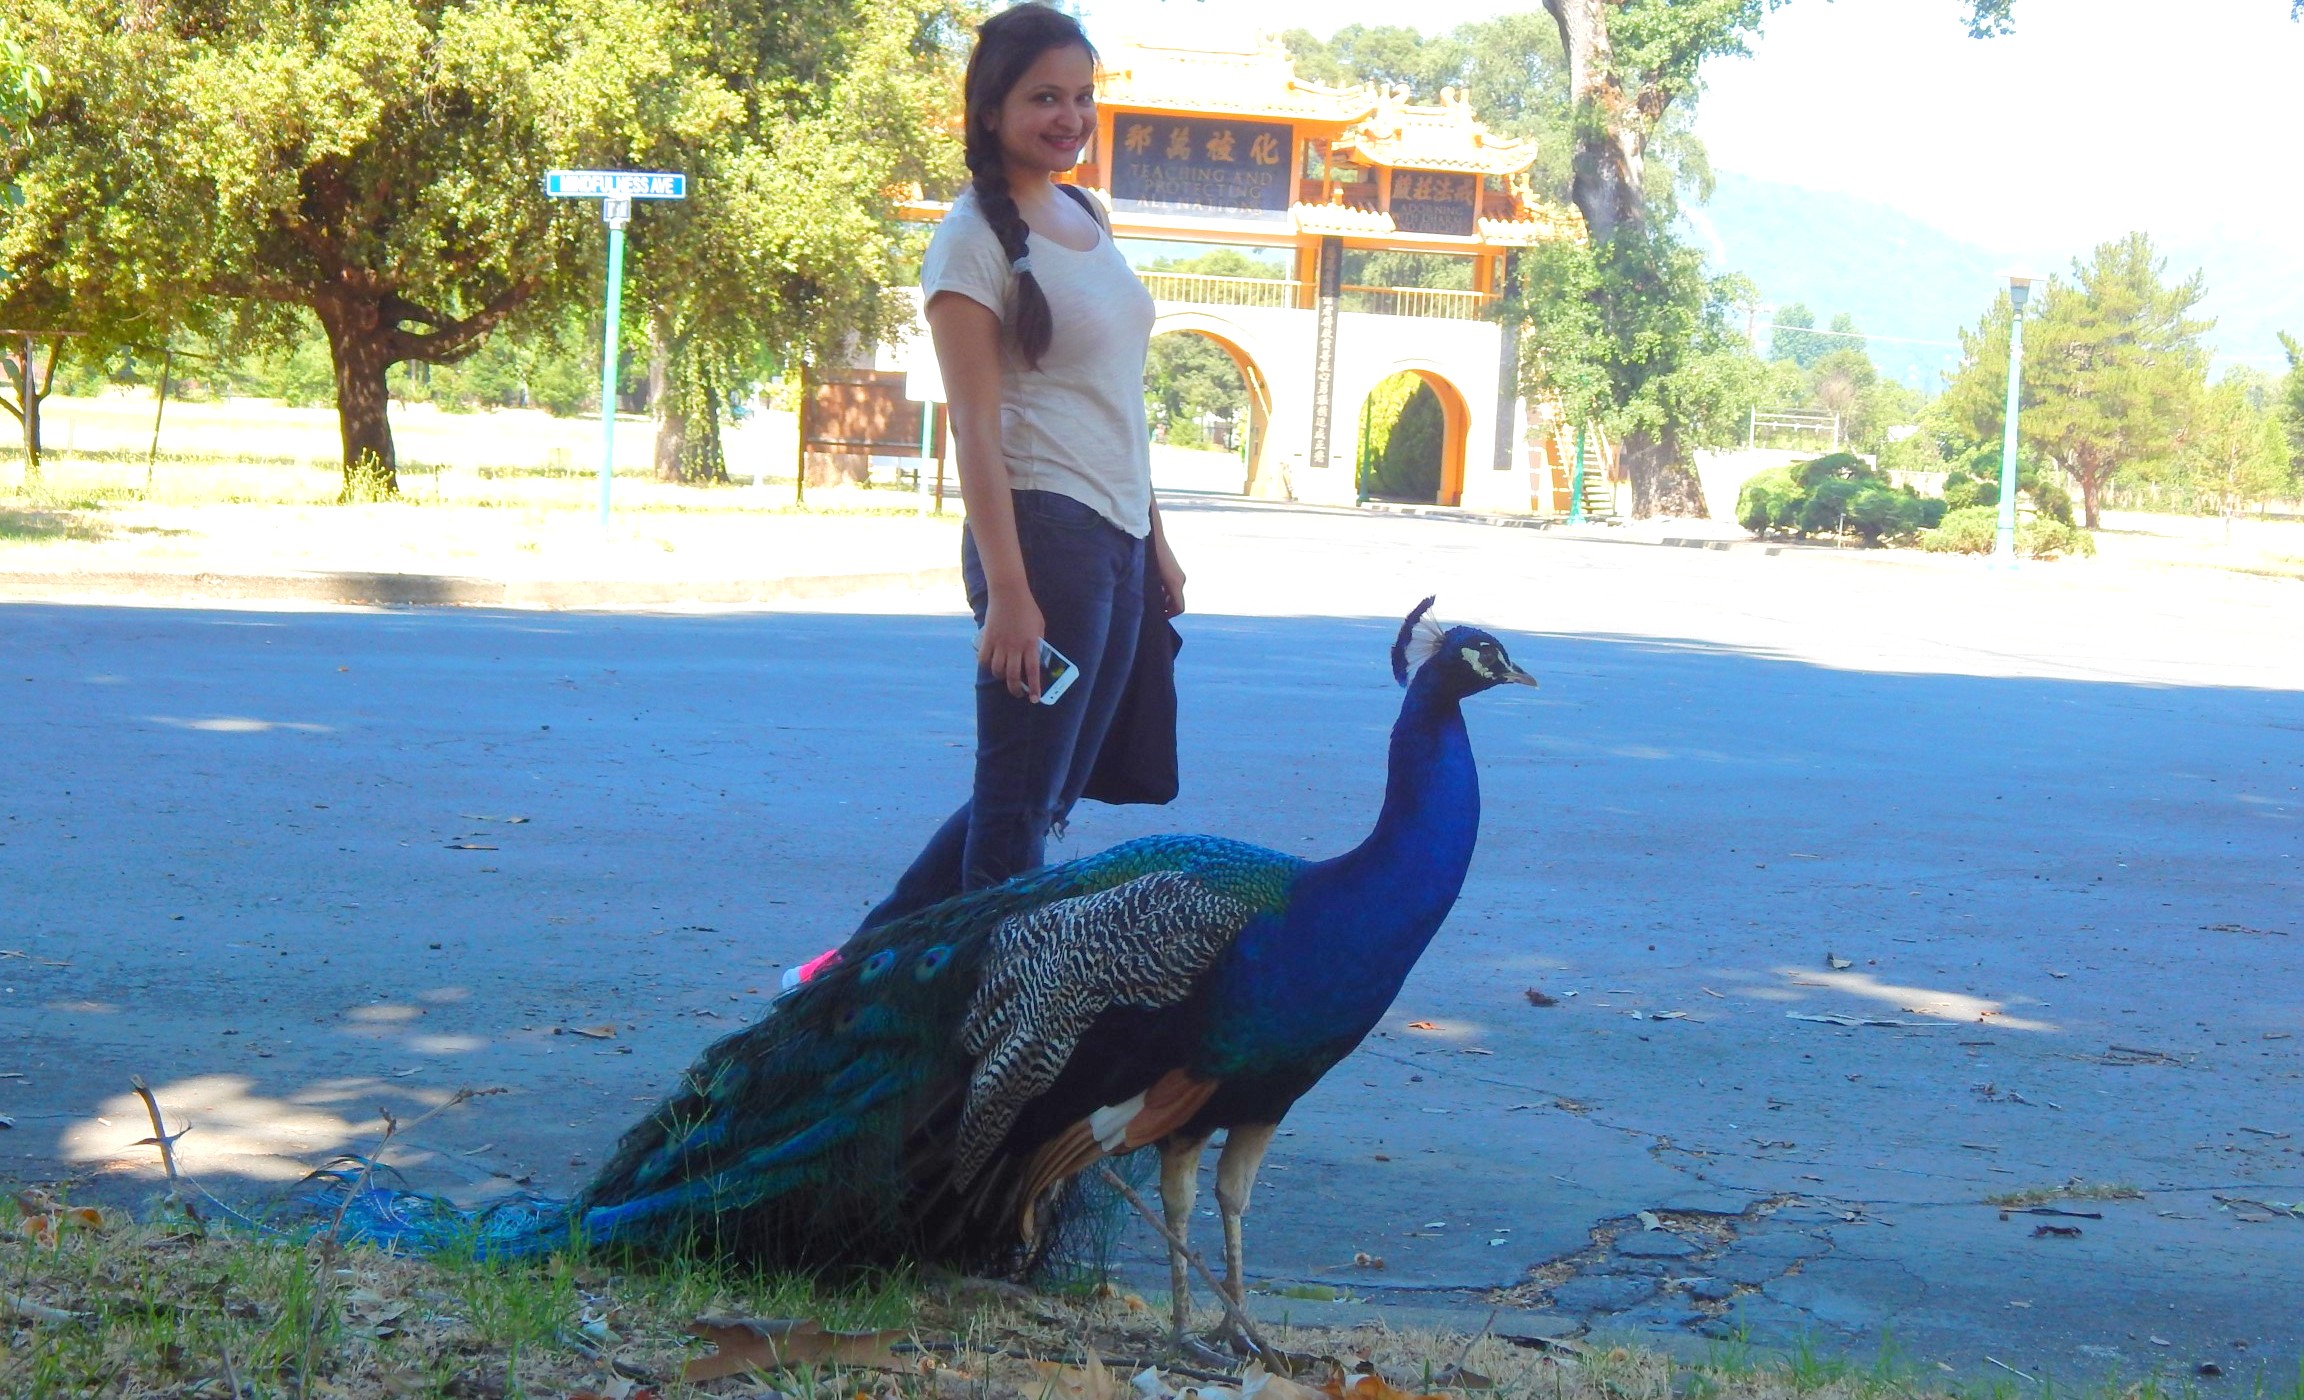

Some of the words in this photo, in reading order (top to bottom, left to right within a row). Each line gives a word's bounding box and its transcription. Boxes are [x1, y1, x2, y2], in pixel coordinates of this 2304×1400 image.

[650, 177, 674, 194] AVE
[1130, 163, 1226, 183] TEACHING
[1232, 171, 1273, 186] AND
[1144, 177, 1262, 199] PROTECTING
[1137, 194, 1168, 210] ALL
[1175, 196, 1263, 216] NATIONS
